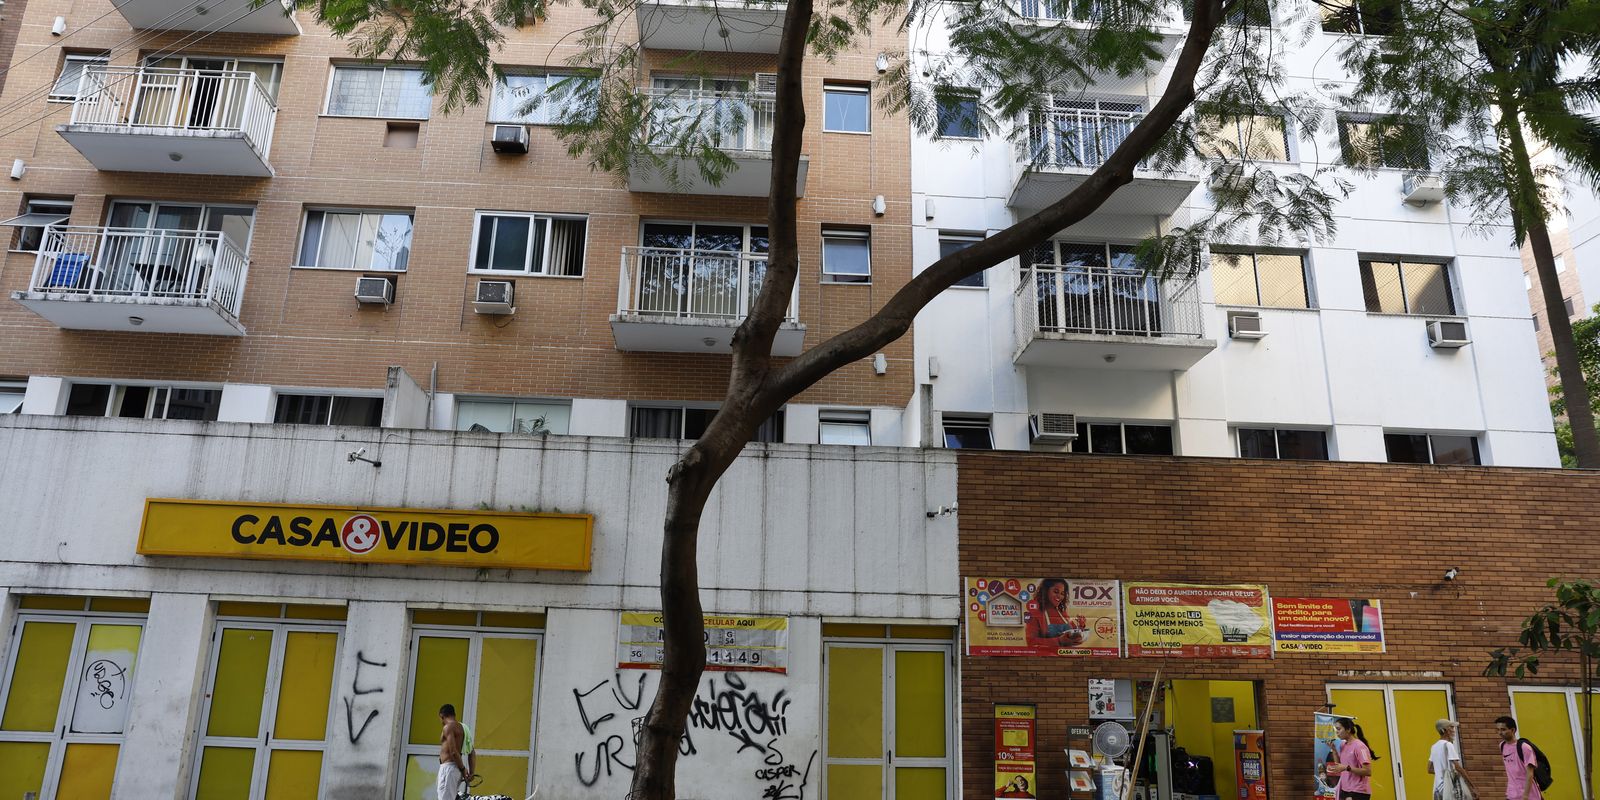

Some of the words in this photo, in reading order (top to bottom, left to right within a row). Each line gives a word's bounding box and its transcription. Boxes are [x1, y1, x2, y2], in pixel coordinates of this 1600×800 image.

[231, 514, 500, 554] CASA&VIDEO
[1072, 586, 1114, 600] 10X
[1135, 587, 1149, 595] NÃO
[1135, 609, 1176, 618] LÂMPADAS
[1187, 611, 1202, 619] LED
[704, 617, 735, 626] CELULAR
[1152, 628, 1186, 636] ENERGIA.
[997, 751, 1015, 760] 10%
